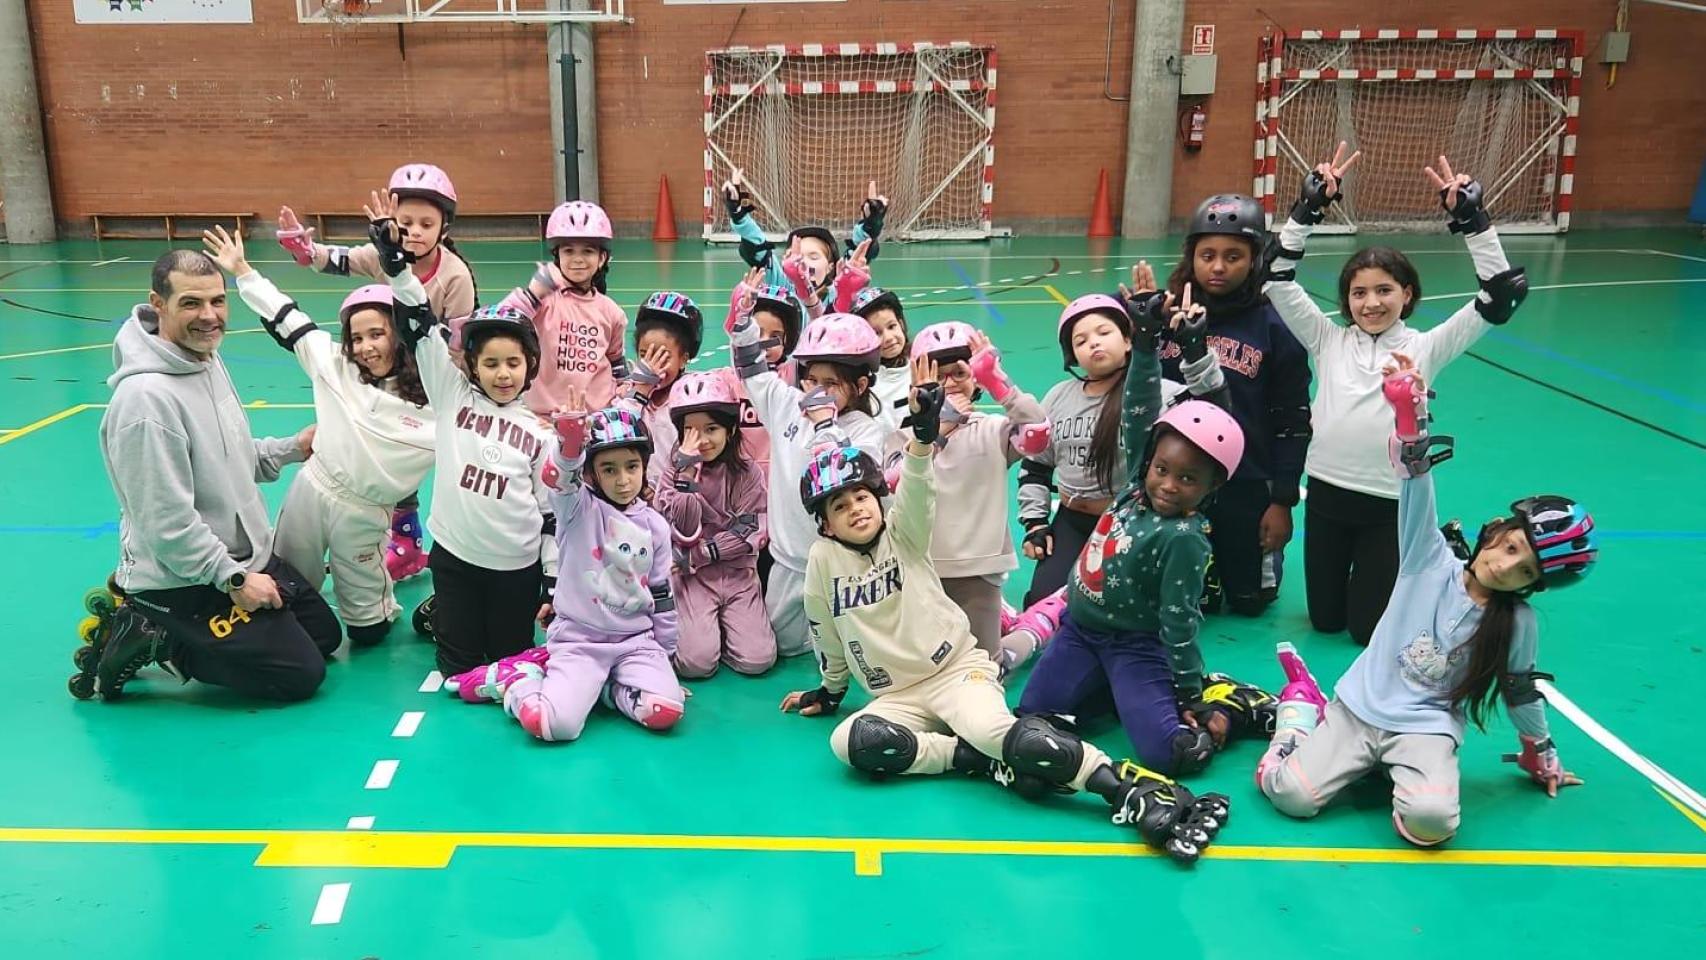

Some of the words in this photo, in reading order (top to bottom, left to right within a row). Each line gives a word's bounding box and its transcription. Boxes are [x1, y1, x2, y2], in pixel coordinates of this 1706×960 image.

[560, 321, 599, 337] HUGO
[559, 334, 598, 349] HUGO
[558, 346, 598, 361] HUGO
[557, 360, 598, 373] HUGO
[456, 406, 494, 438] NEW
[460, 464, 510, 500] CITY
[209, 605, 252, 638] 64
